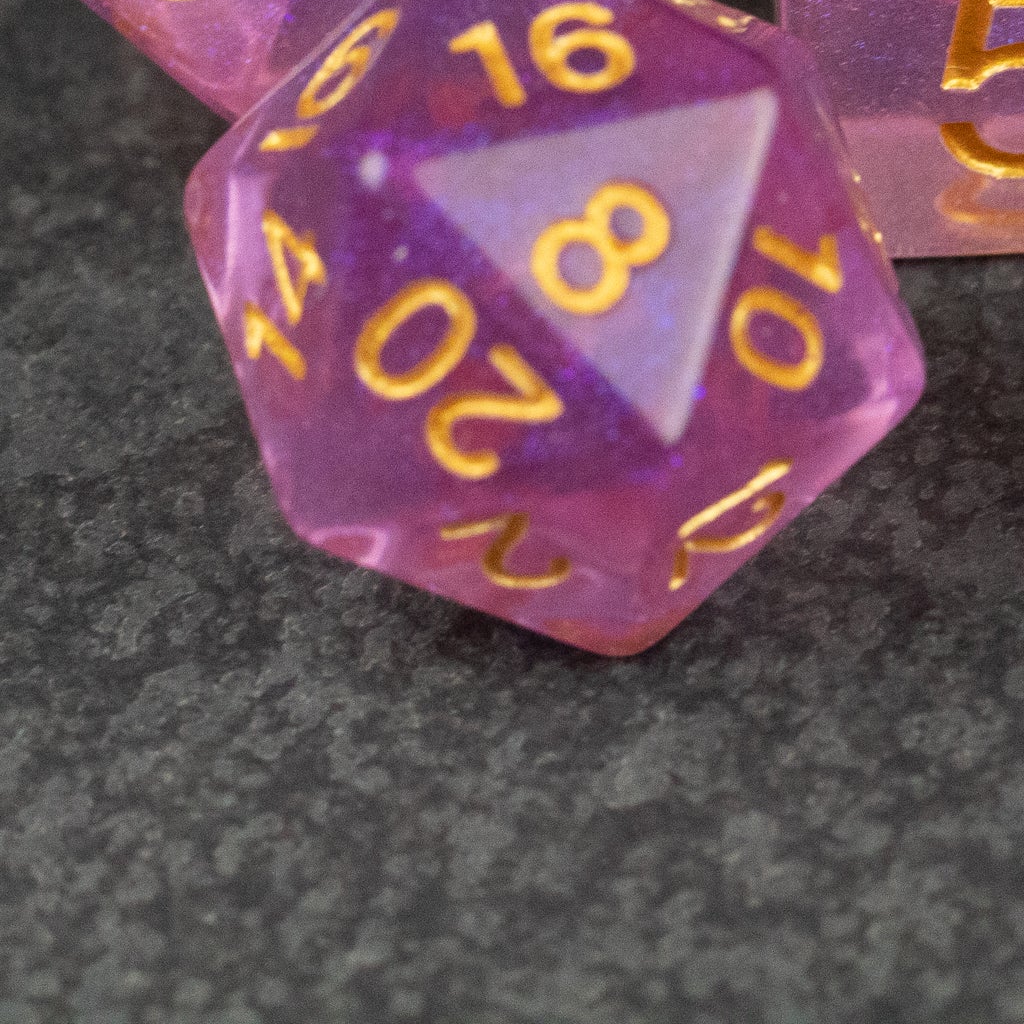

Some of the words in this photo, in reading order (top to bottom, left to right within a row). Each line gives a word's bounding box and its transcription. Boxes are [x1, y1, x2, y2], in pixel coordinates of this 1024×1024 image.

[446, 2, 636, 107] 16
[530, 181, 671, 314] 8
[729, 226, 842, 390] 10
[354, 280, 564, 479] 20
